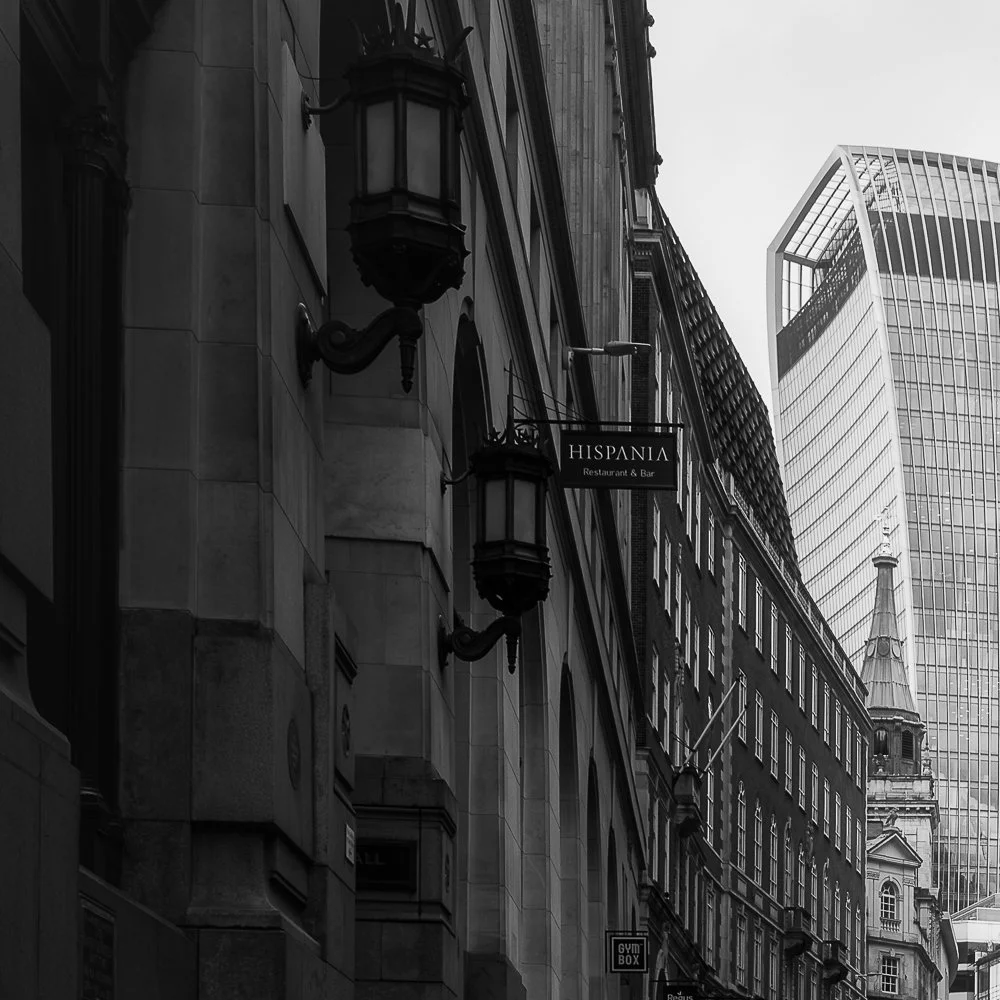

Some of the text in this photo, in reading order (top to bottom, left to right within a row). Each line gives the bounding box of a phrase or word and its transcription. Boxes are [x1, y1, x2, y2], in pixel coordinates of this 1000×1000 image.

[568, 443, 670, 462] HISPANIA
[583, 467, 656, 478] Restaurant & Bar
[617, 942, 641, 955] GYM
[617, 954, 641, 966] BOX
